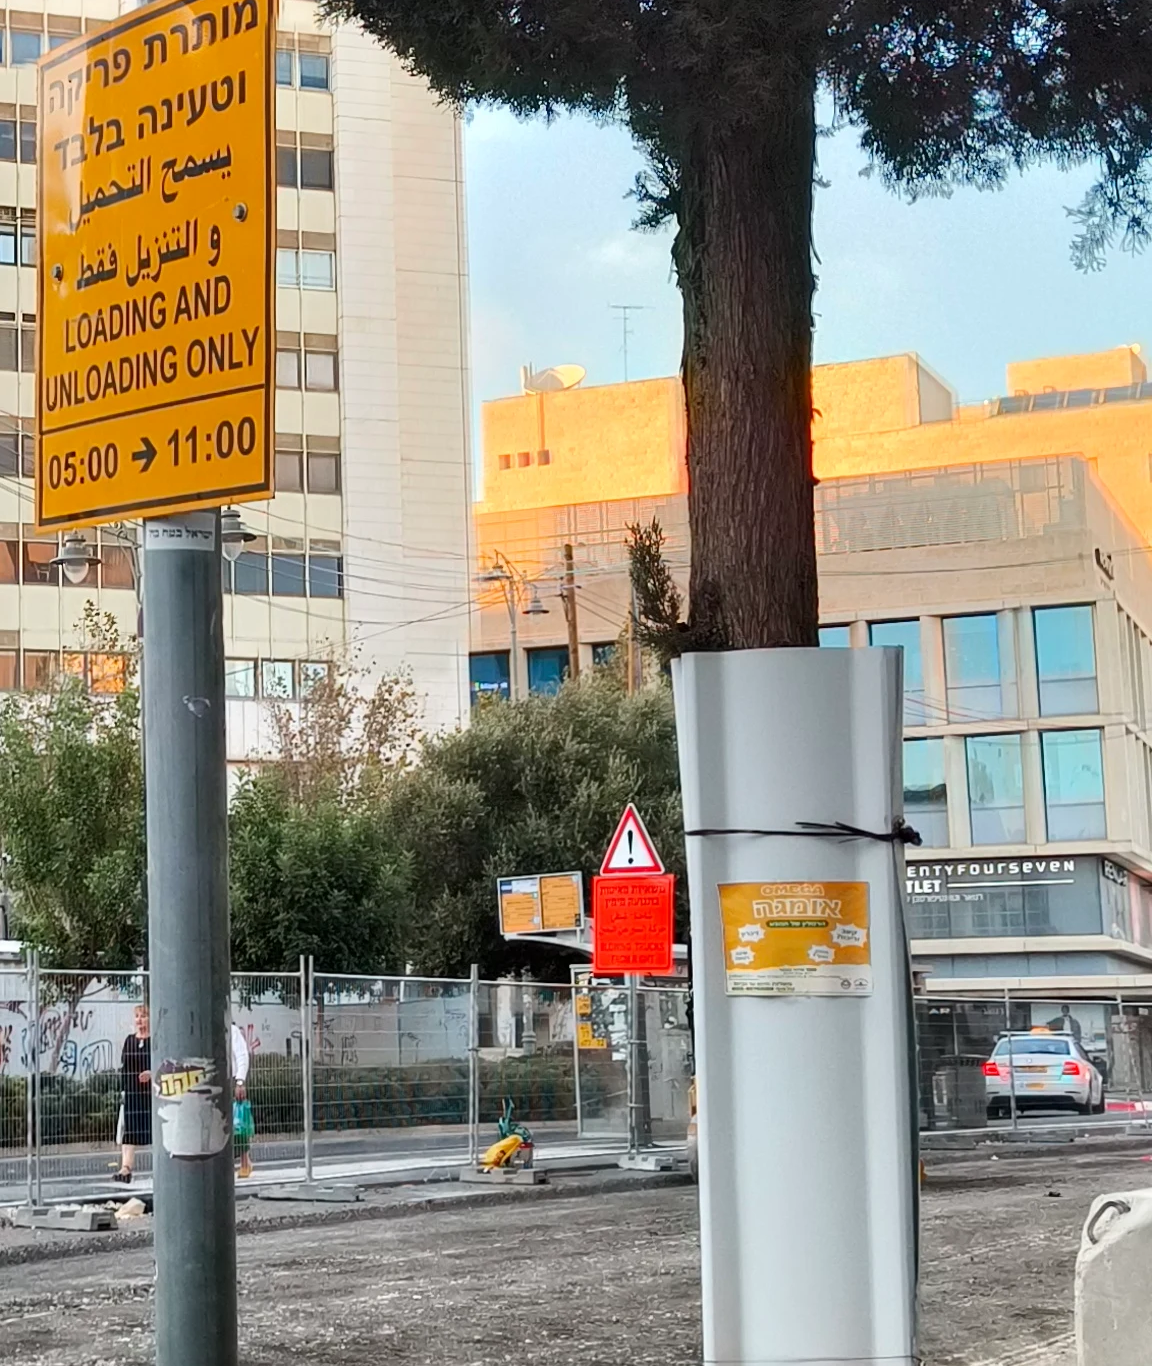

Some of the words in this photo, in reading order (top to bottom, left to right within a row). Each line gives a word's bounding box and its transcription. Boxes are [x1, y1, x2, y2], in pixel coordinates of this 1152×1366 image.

[49, 43, 131, 115] פריקה
[136, 70, 248, 139] וטעינה
[54, 110, 125, 172] בלבד
[161, 141, 233, 204] يسمح
[75, 244, 118, 292] فقط
[125, 217, 199, 288] التنزيل
[64, 292, 167, 355] LOADING
[174, 275, 232, 324] AND
[45, 345, 178, 413] UNLOADING
[186, 325, 260, 379] ONLY
[48, 442, 120, 490] 05:00
[166, 416, 257, 468] 11:00
[752, 898, 843, 919] אומגה
[761, 883, 825, 896] OMEGA
